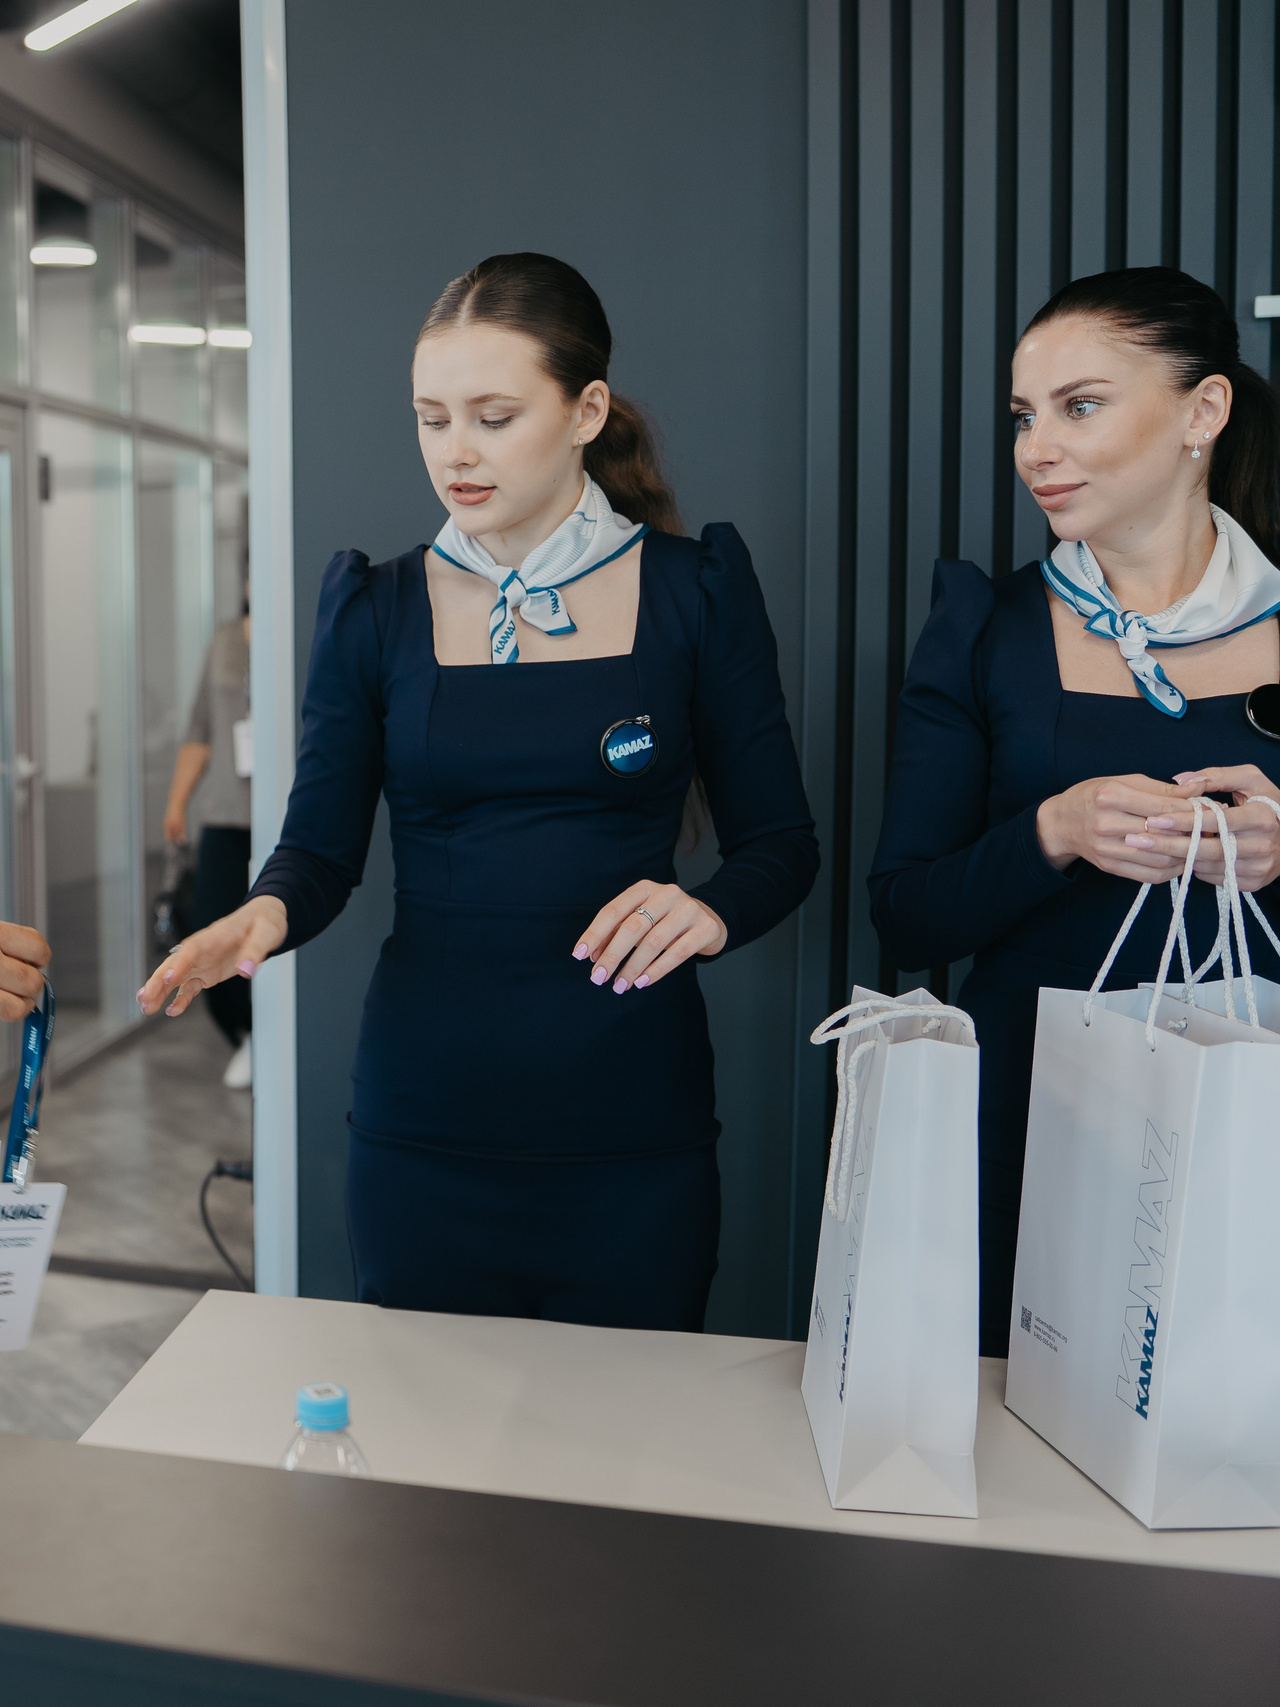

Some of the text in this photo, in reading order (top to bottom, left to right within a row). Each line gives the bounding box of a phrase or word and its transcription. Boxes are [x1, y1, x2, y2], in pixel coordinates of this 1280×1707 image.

[494, 620, 516, 655] KAMAZ
[607, 734, 653, 762] KAMAZ
[1115, 1118, 1179, 1418] KAMAZ
[1135, 1304, 1159, 1421] KAMAZ
